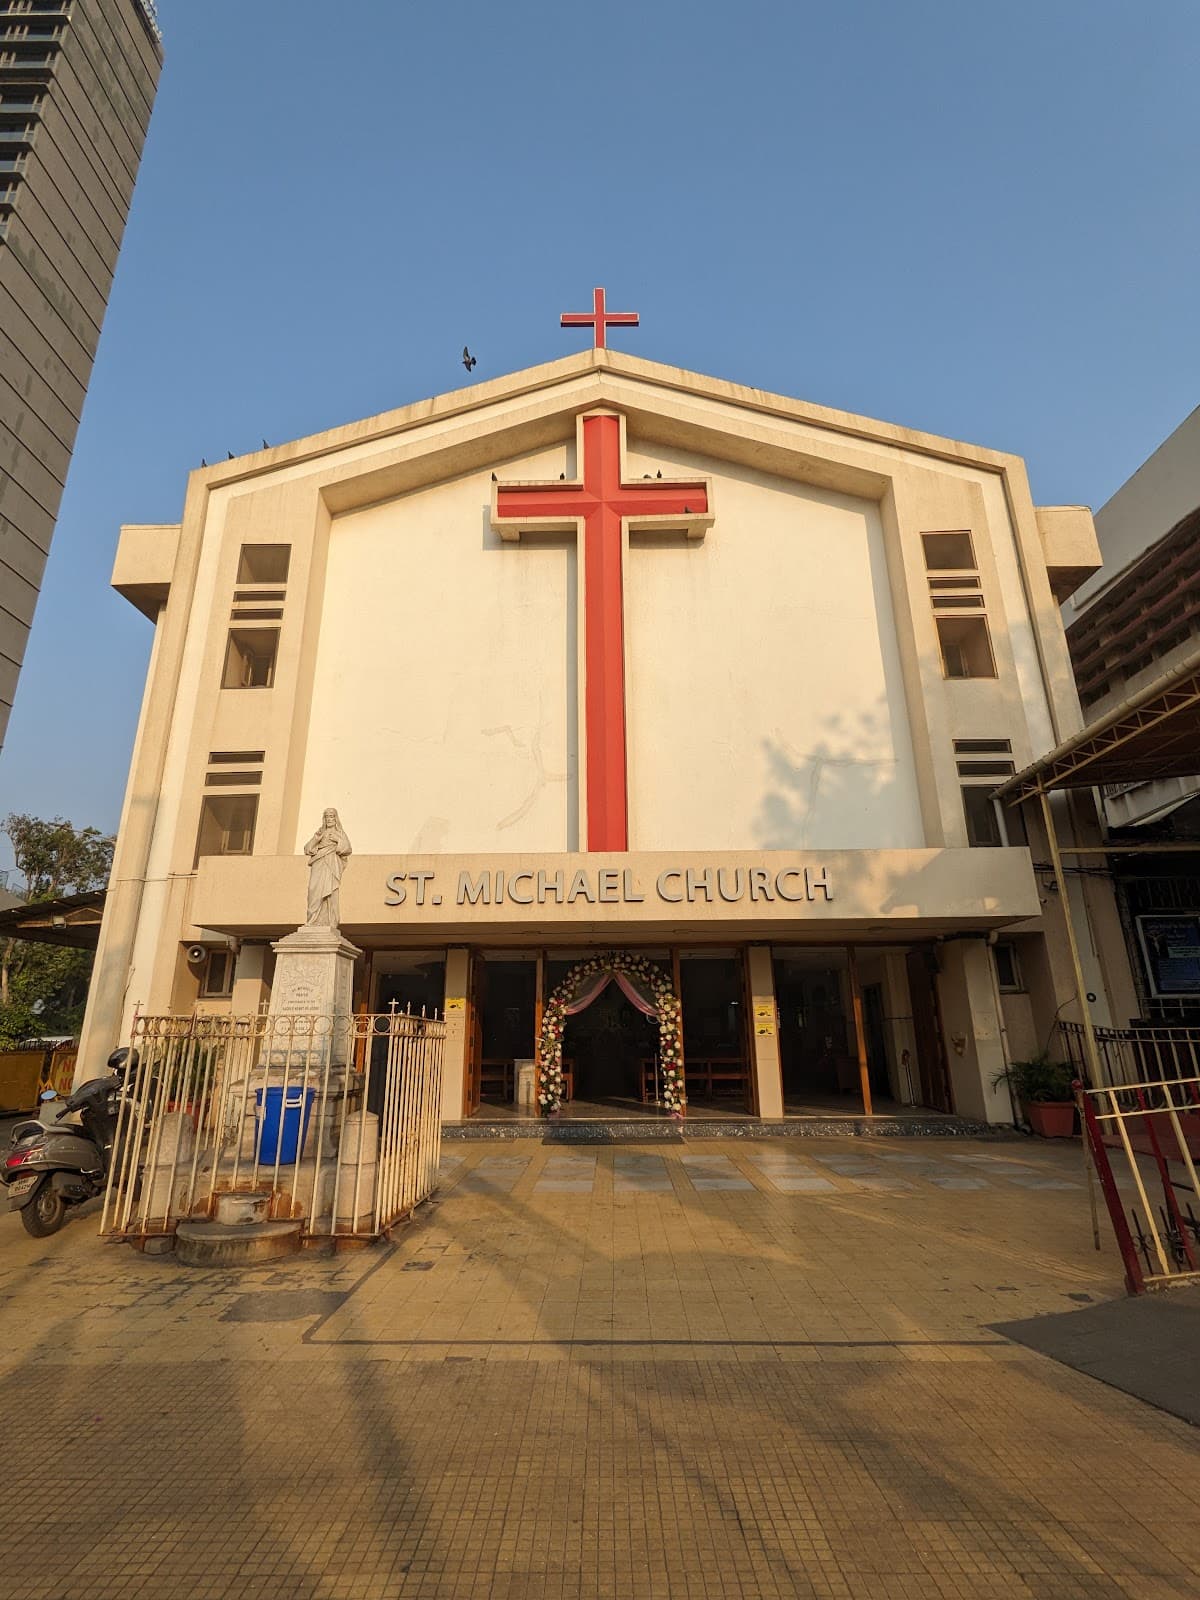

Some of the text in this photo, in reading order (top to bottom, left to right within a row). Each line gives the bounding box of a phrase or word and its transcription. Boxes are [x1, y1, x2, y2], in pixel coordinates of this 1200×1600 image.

[384, 867, 833, 906] ST. MICHAEL CHURCH
